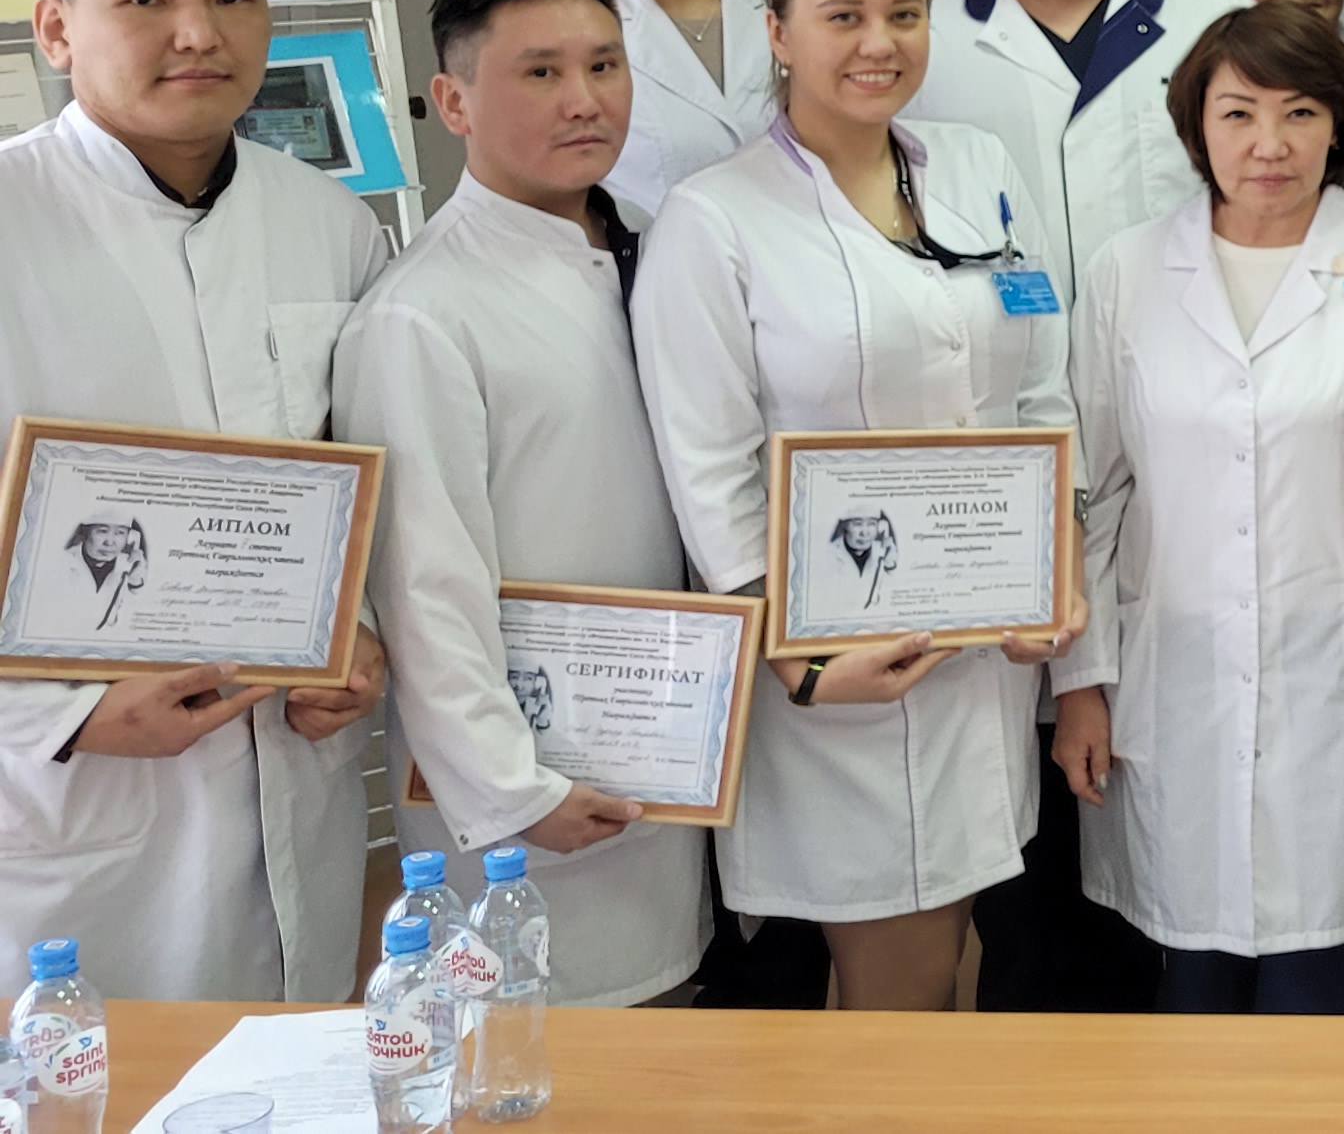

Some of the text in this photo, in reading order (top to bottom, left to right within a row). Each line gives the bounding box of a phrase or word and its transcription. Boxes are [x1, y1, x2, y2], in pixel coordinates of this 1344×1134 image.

[926, 500, 1009, 517] ДИПЛОМ
[188, 517, 292, 537] ДИПЛОМ
[565, 662, 705, 685] СЕРТИФИКАТ
